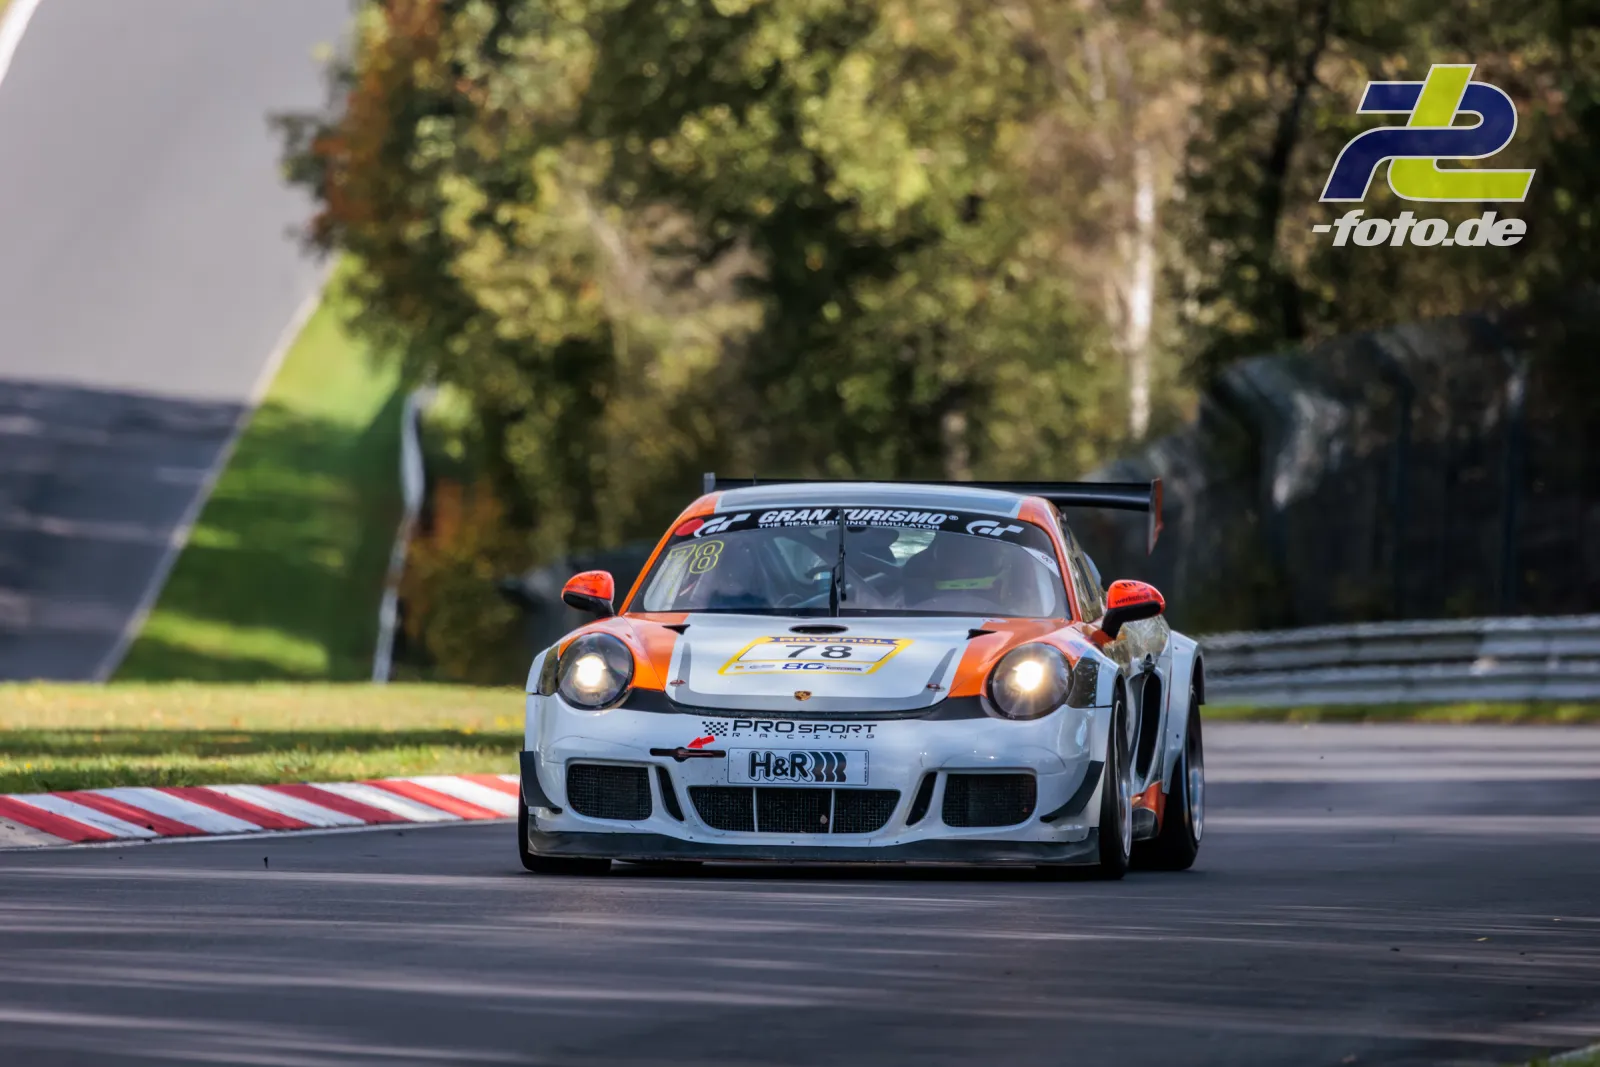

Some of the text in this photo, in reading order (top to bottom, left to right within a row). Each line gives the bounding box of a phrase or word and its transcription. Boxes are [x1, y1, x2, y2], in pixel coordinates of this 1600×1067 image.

[758, 509, 832, 524] GRAN
[818, 519, 868, 527] DRIING
[870, 520, 940, 531] SIMULATOR
[785, 644, 853, 659] 78
[732, 719, 878, 734] PRO SPORT
[749, 751, 813, 782] H&R
